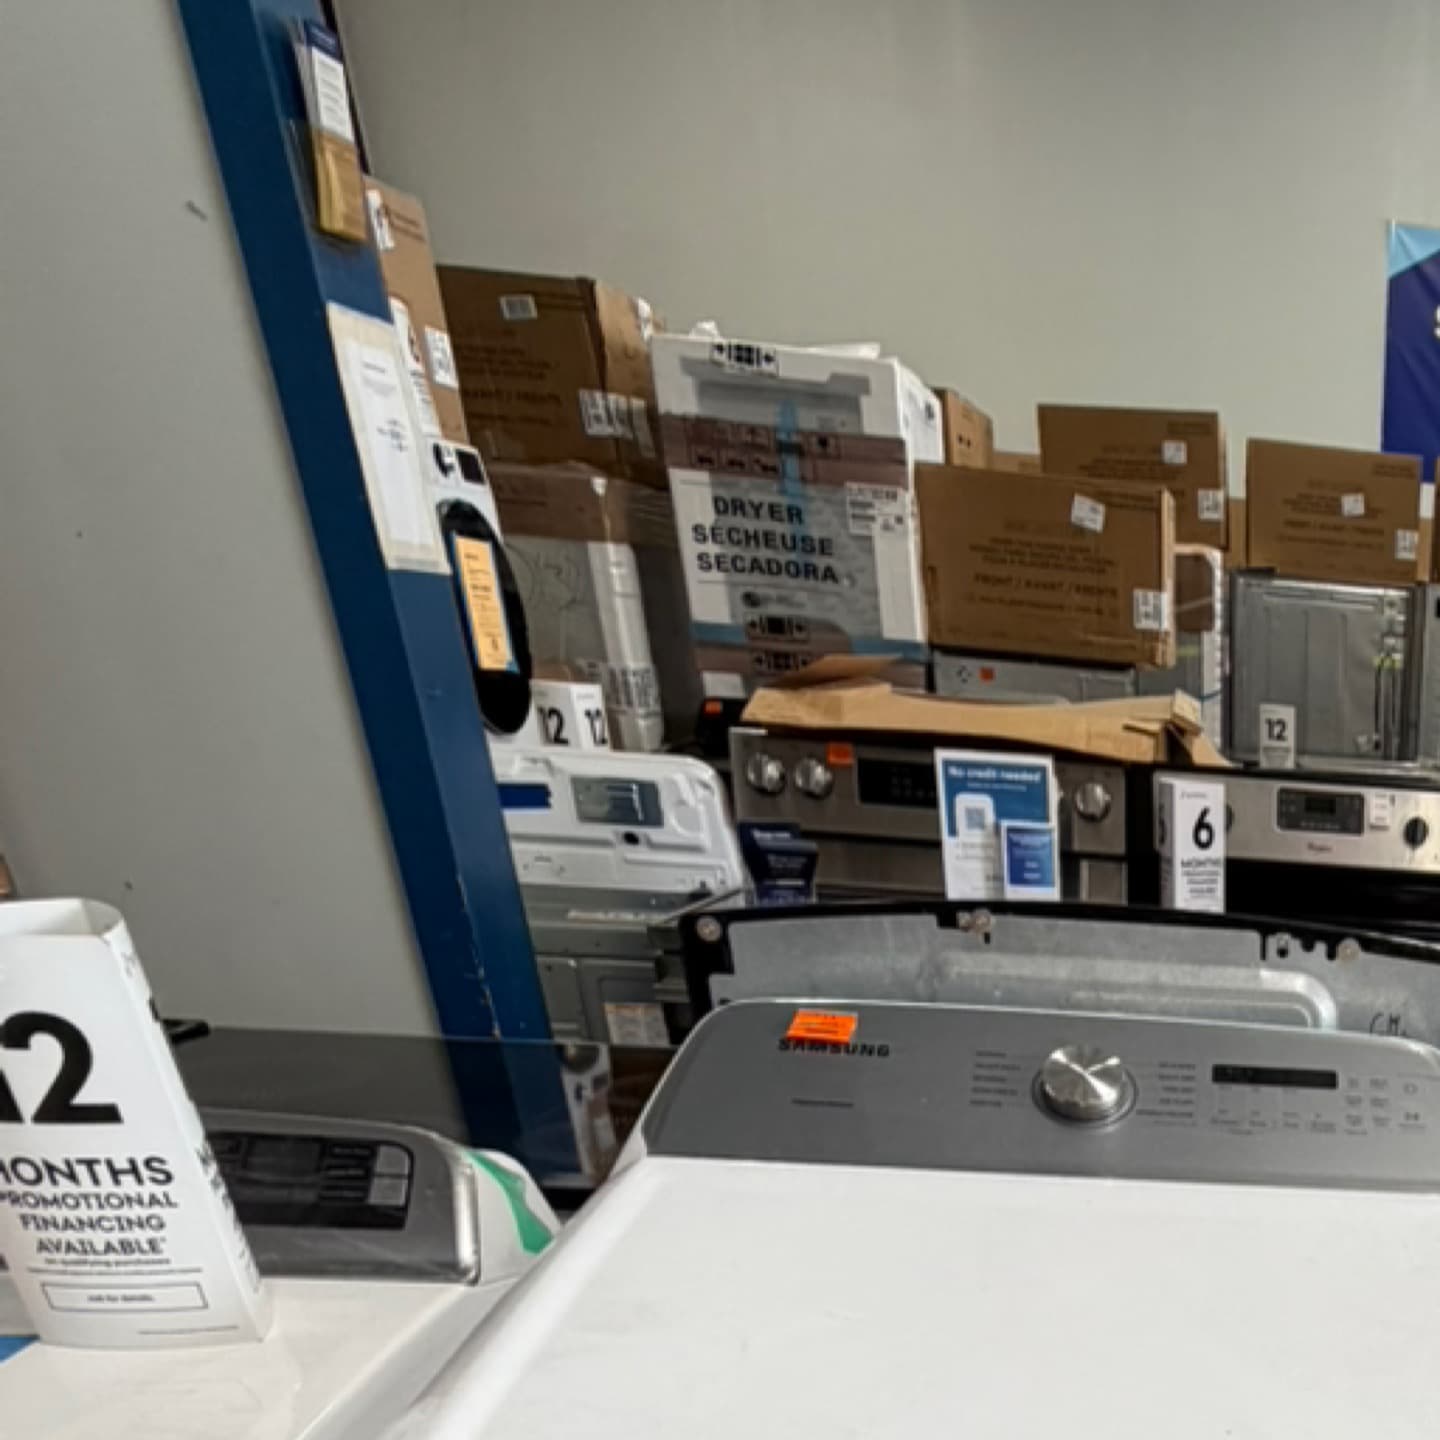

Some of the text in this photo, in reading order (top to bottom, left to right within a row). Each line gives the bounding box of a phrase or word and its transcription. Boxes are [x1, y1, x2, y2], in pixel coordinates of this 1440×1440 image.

[713, 496, 804, 525] DRYER
[692, 523, 834, 557] SECHEUSE
[697, 552, 839, 585] SECADORA
[1265, 718, 1287, 741] 12
[1192, 805, 1215, 851] 6
[778, 1038, 890, 1057] SAMSUNG
[19, 1213, 166, 1232] FINANCING
